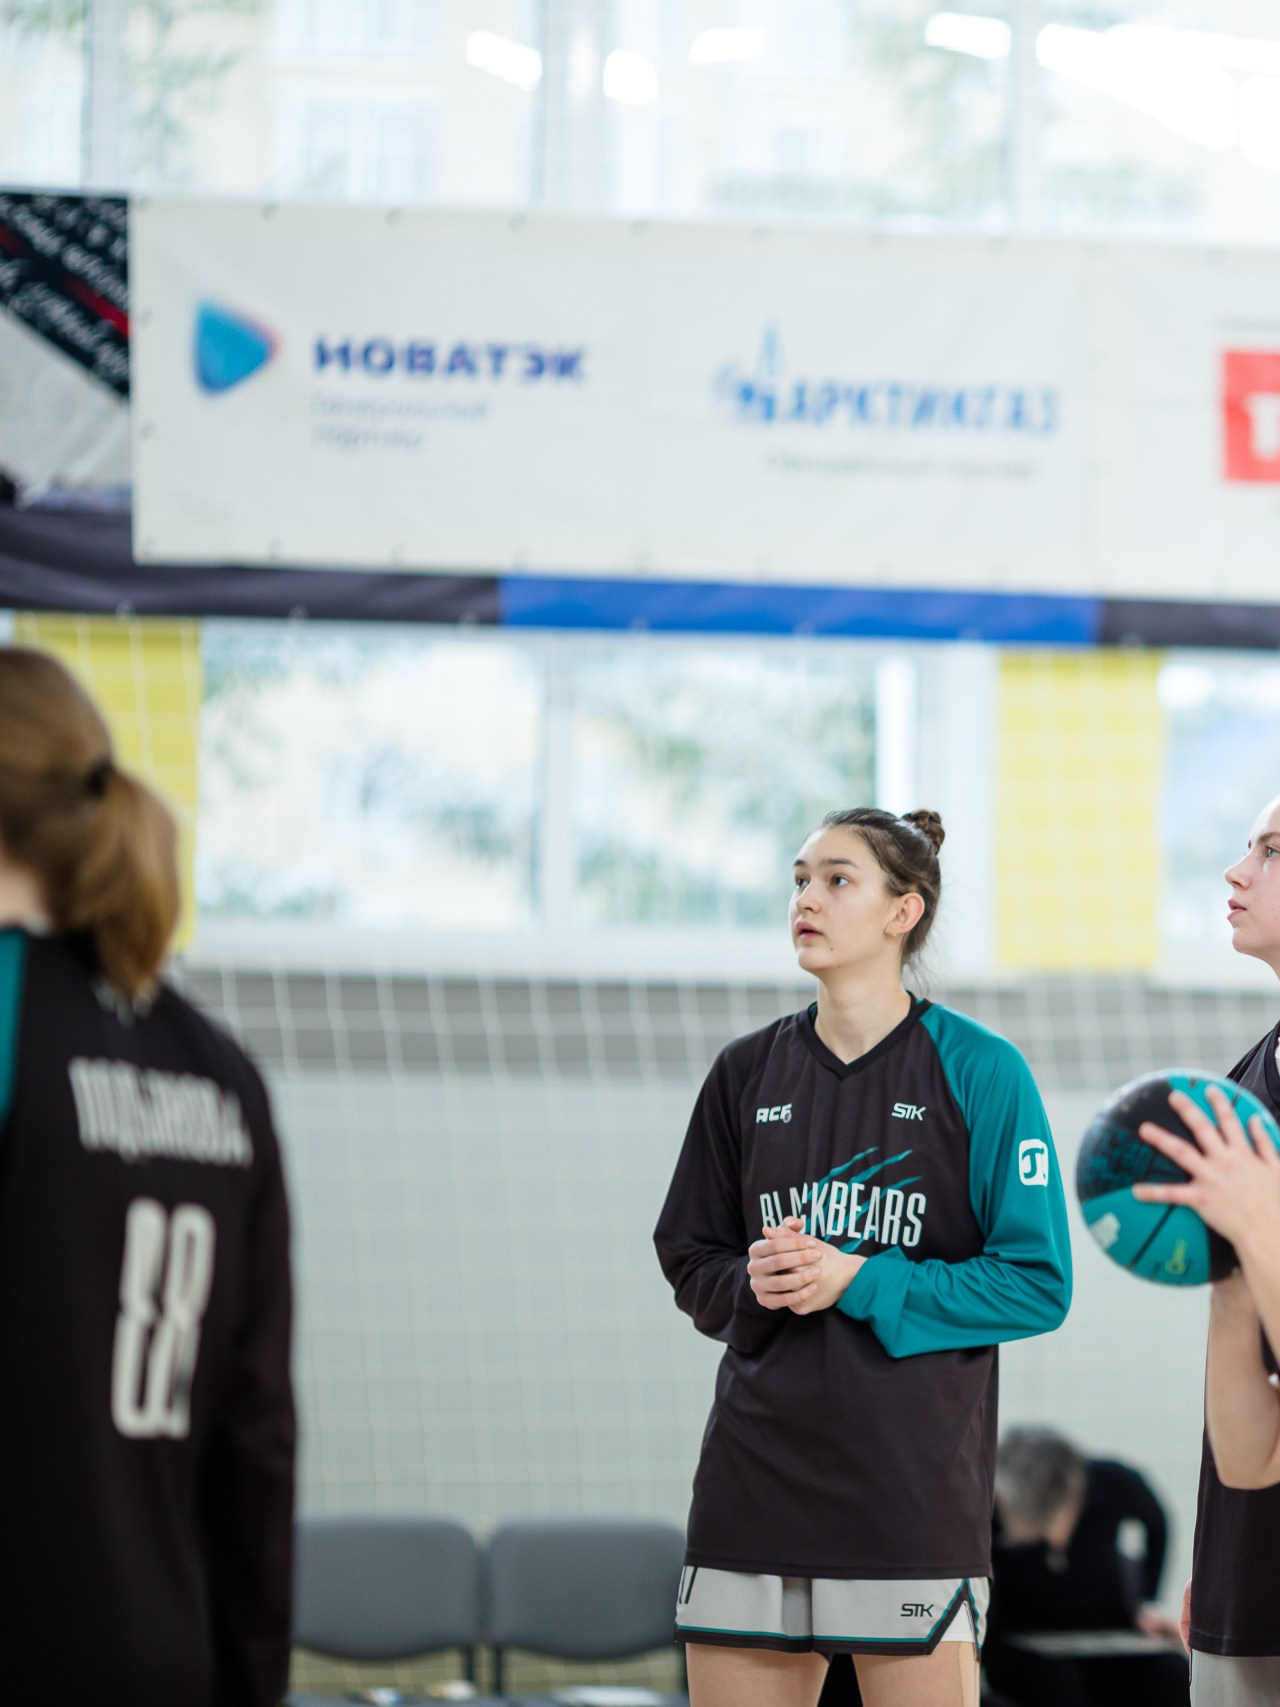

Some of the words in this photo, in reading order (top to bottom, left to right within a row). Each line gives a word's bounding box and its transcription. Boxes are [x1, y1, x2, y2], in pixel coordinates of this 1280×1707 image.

[313, 336, 586, 384] НОВАТЭК
[892, 1102, 926, 1121] STK
[900, 1603, 934, 1618] STK
